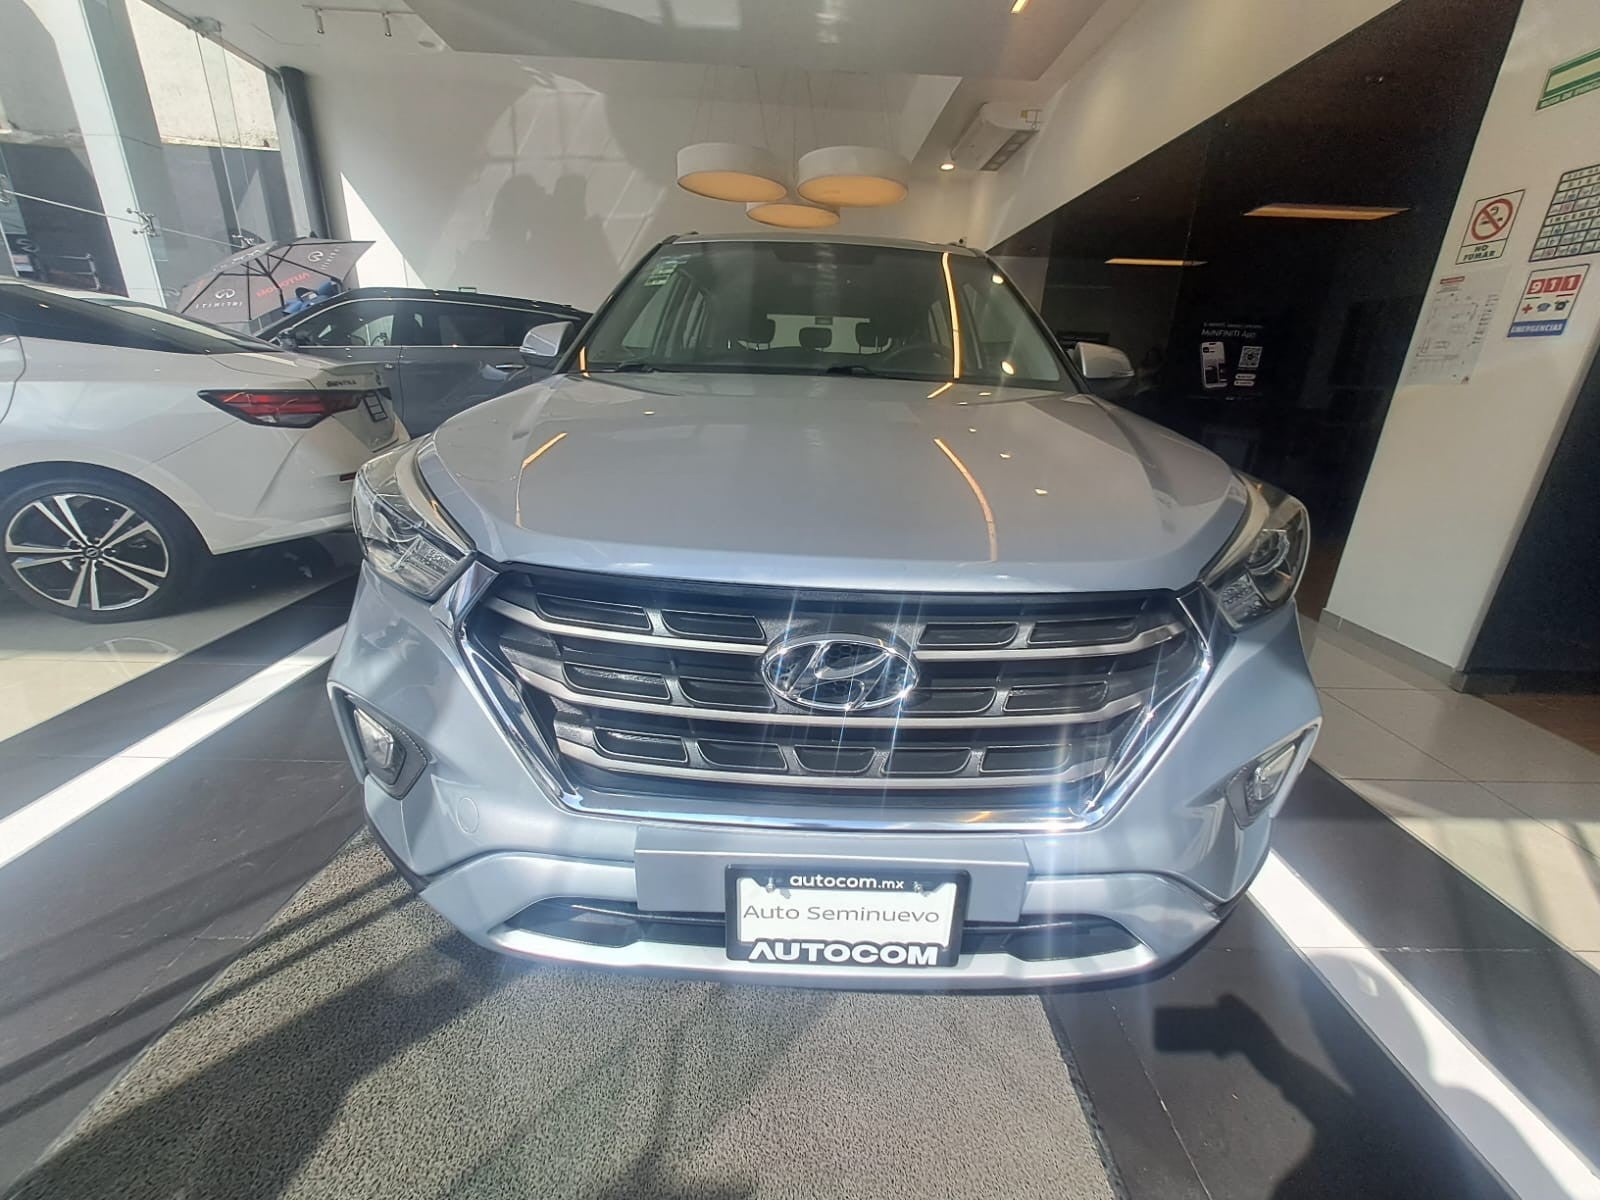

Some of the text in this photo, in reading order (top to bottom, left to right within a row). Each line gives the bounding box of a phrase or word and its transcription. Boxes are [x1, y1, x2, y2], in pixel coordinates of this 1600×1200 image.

[1463, 250, 1496, 261] FUMAR
[1474, 244, 1489, 252] NO
[1530, 276, 1577, 293] 911
[789, 874, 905, 889] autocom.mx
[743, 905, 940, 923] Auto Seminuevo
[748, 941, 939, 966] AUTOCOM
